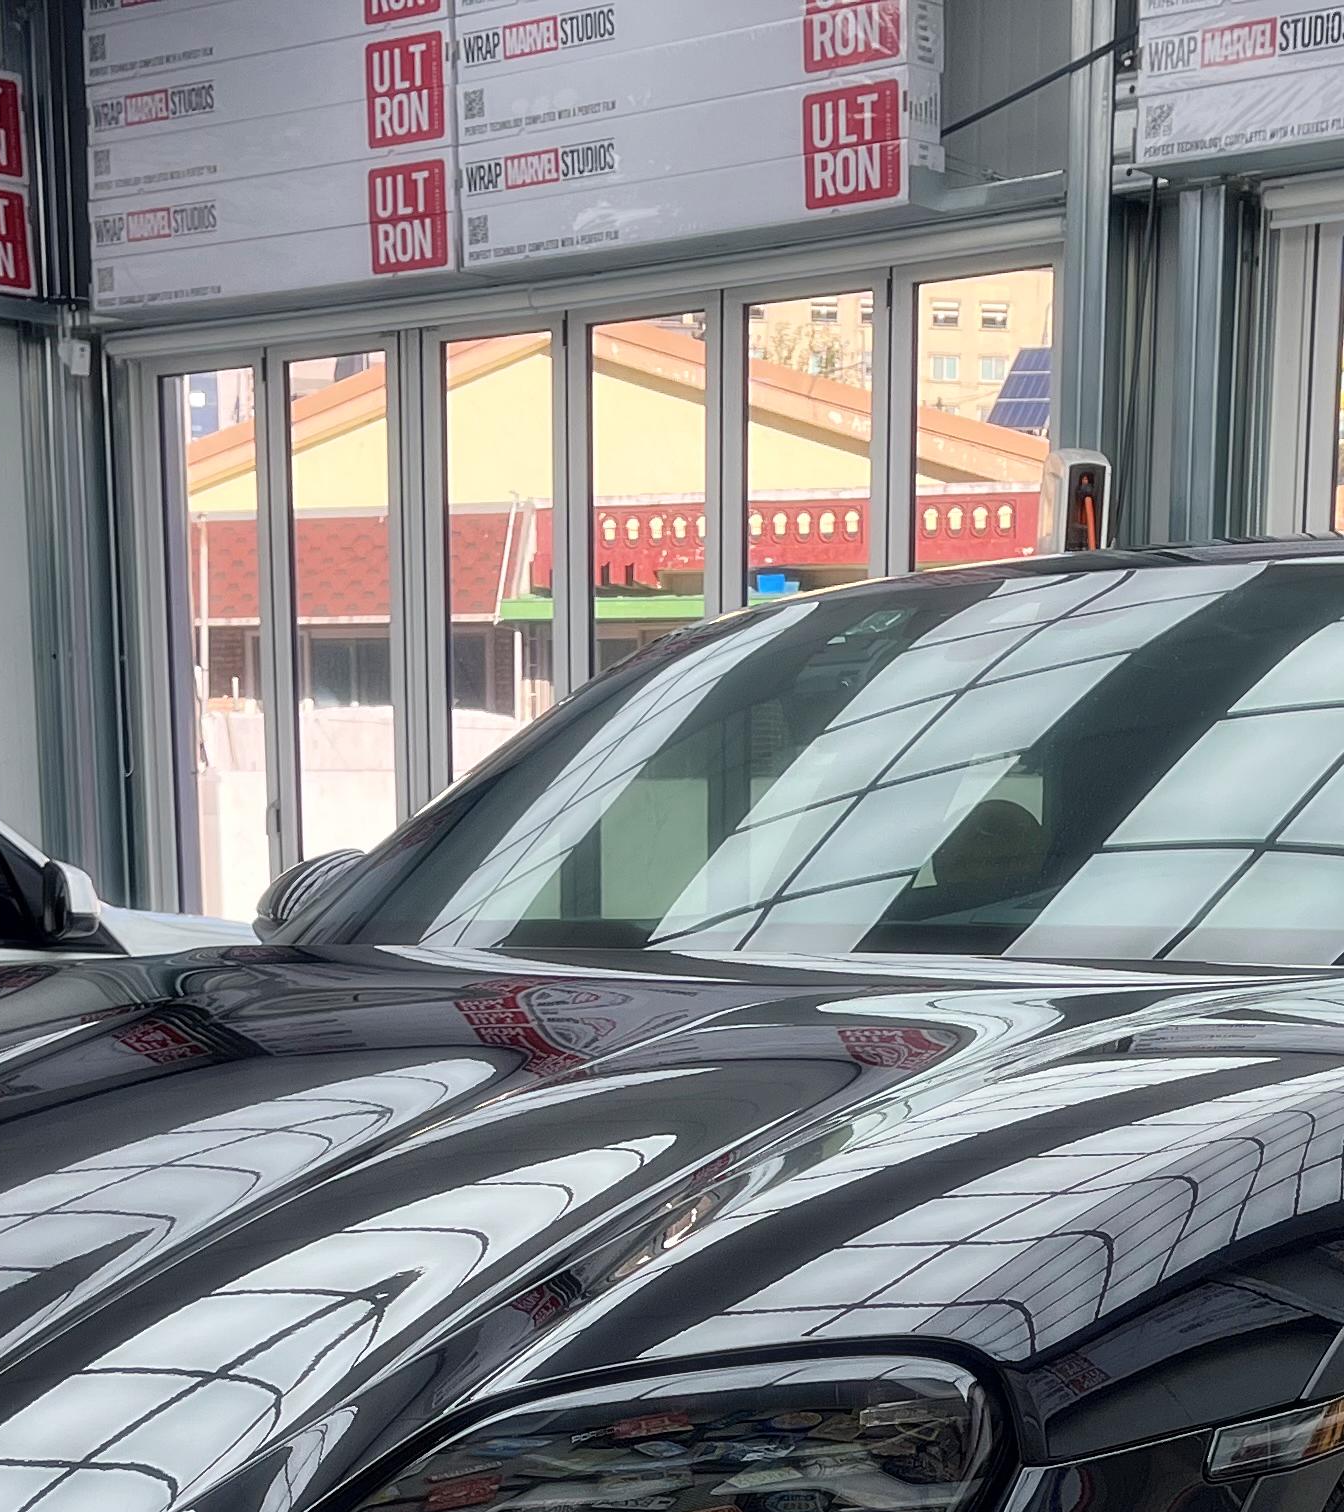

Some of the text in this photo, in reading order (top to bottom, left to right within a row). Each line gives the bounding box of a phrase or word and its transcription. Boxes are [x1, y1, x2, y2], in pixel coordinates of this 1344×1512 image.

[464, 8, 615, 64] WRAP MARVEL STUDIOS
[813, 2, 881, 62] RON
[1148, 34, 1198, 73] WRAP
[1205, 21, 1273, 64] MARVEL
[372, 43, 427, 94] ULT
[170, 84, 215, 115] STUDIOS
[374, 89, 430, 139] RON
[812, 93, 879, 149] ULT
[466, 142, 616, 193] WRAP MARVEL STUDIOS
[813, 144, 881, 199] RON
[173, 204, 217, 234] STUDIOS
[375, 170, 430, 218] ULT
[378, 218, 433, 265] RON
